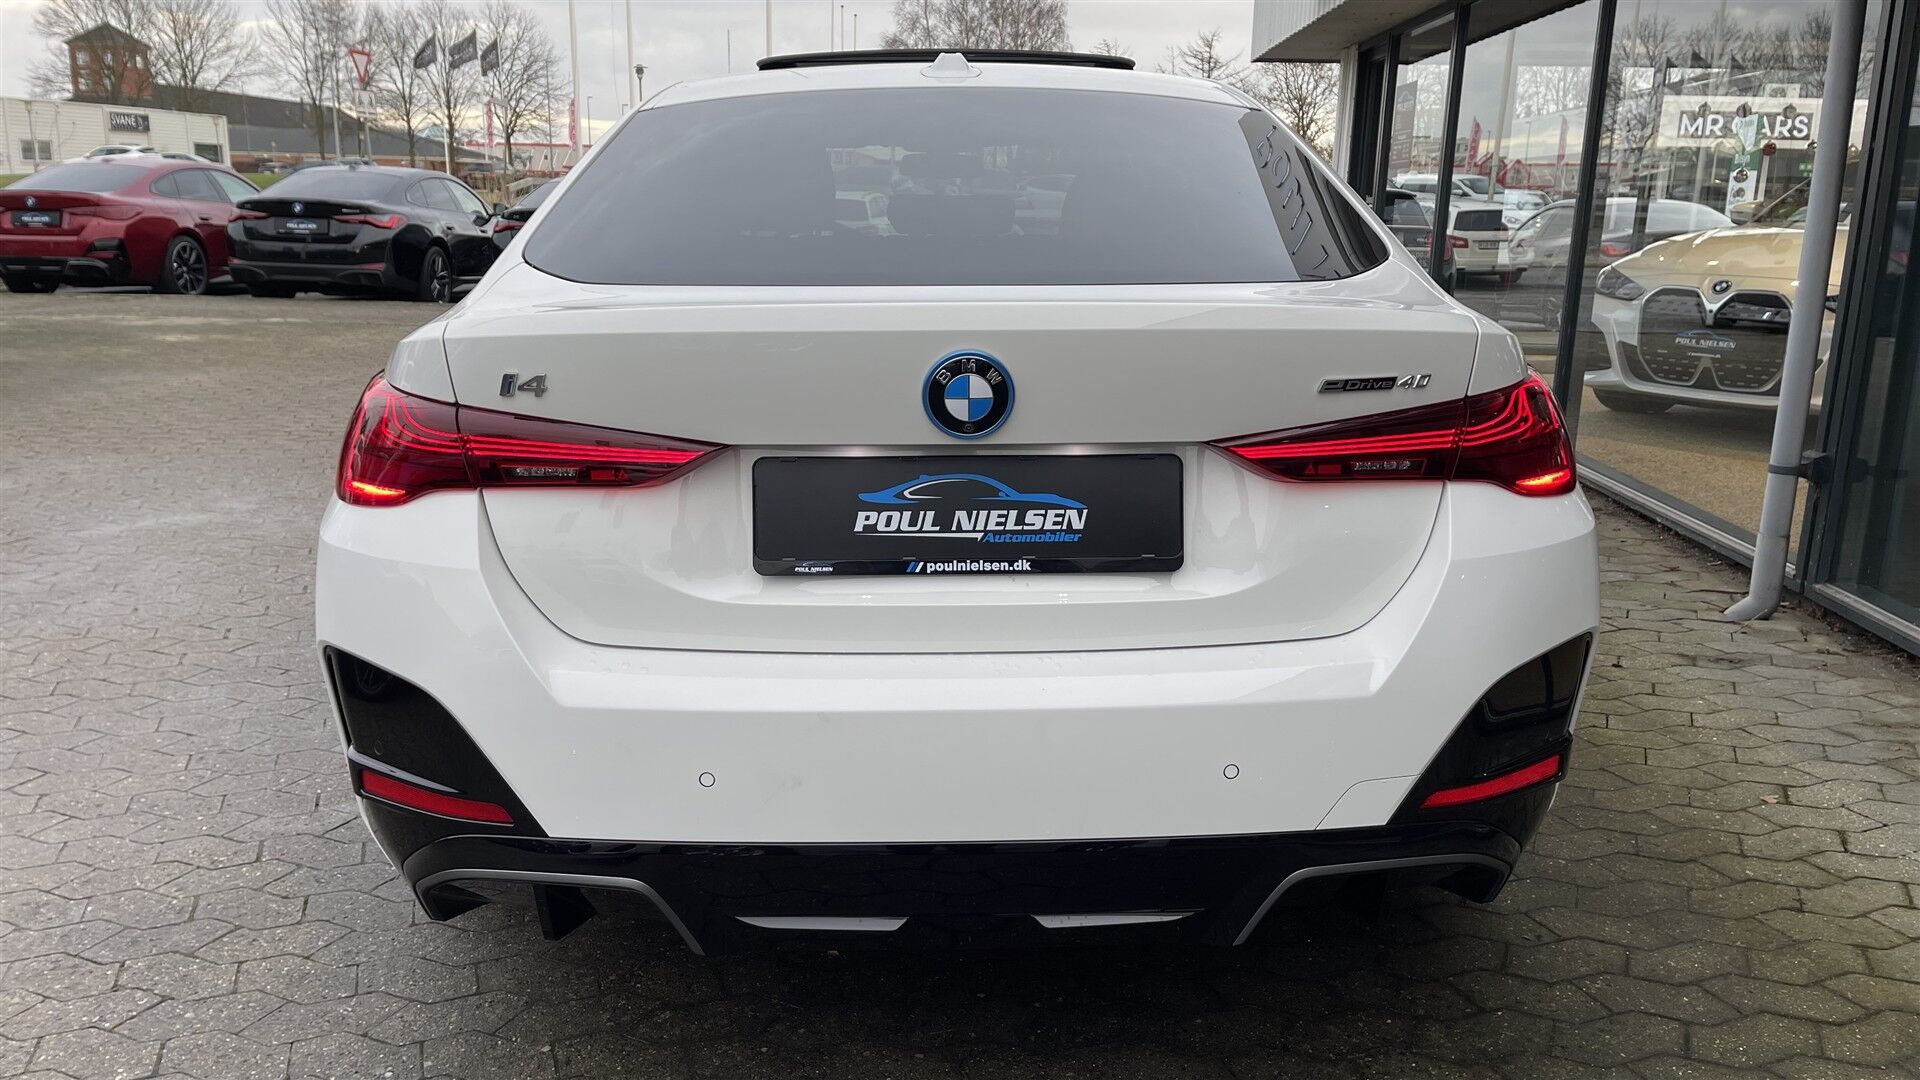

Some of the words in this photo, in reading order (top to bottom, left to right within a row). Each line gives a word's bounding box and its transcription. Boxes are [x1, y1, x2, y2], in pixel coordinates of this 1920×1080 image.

[111, 113, 136, 127] SVANE
[1679, 113, 1724, 136] MR
[936, 359, 1003, 386] BMW
[499, 373, 548, 397] i4
[1318, 376, 1398, 393] eDrive
[1397, 374, 1432, 389] 40
[853, 510, 940, 532] POUL
[951, 509, 1088, 531] NIELSEN
[983, 532, 1082, 543] Automobiler
[926, 559, 1032, 573] poulnielsen.dk
